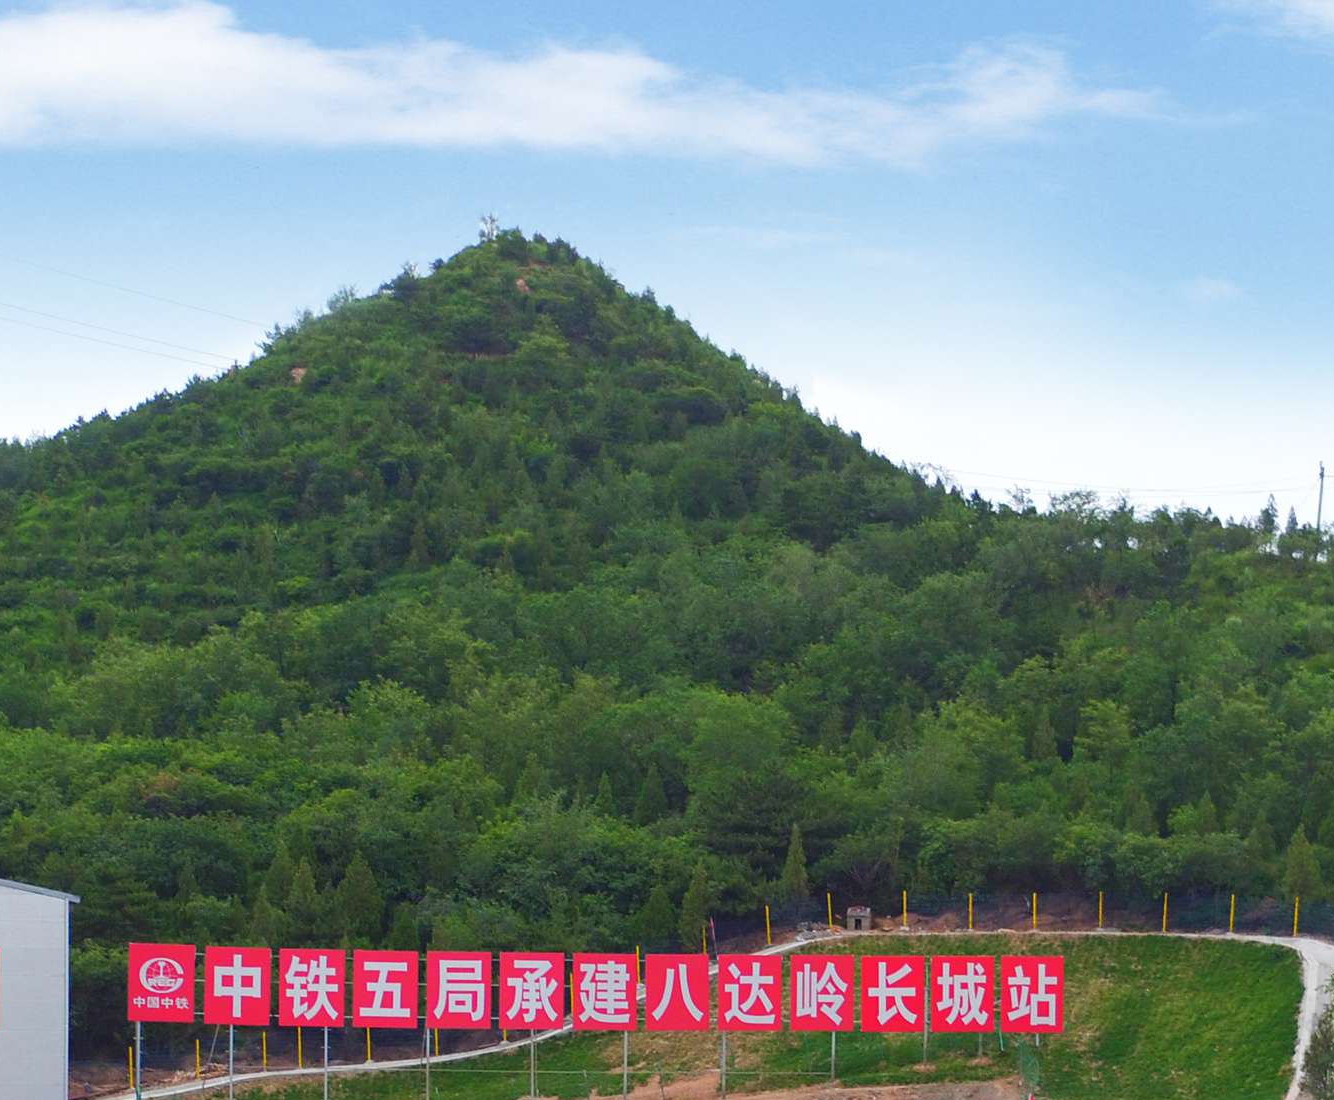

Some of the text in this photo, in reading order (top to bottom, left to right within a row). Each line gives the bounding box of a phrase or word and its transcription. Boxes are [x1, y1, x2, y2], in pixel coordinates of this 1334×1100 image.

[133, 996, 188, 1009] 中国中铁
[213, 953, 1058, 1027] 中铁五局承建八达岭长城站
